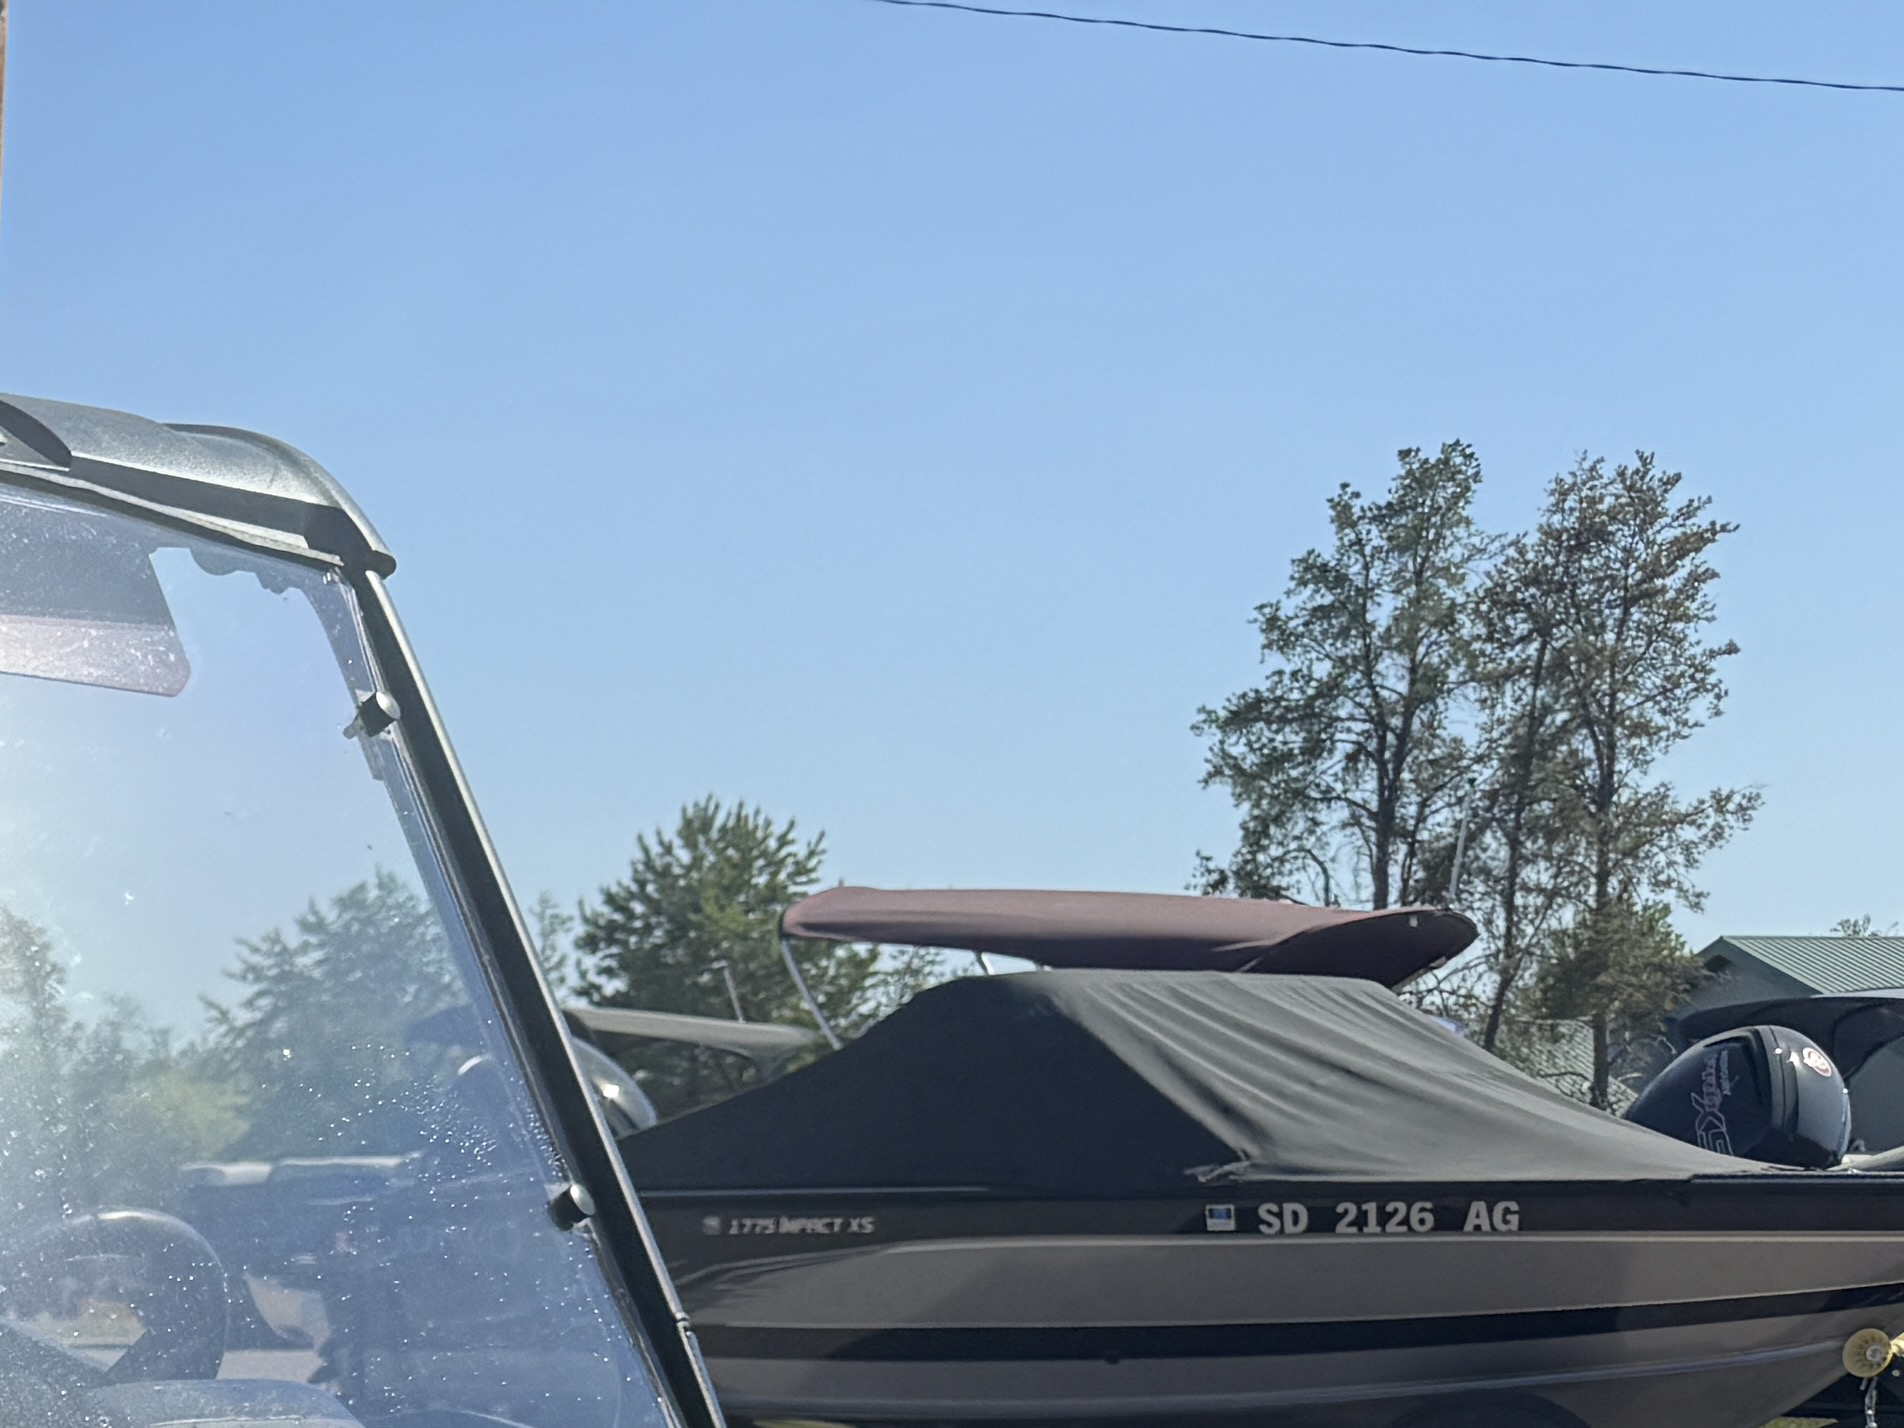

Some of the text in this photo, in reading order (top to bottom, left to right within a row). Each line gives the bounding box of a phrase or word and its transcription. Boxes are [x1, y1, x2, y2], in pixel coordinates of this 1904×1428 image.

[729, 1217, 775, 1234] 1775
[848, 1216, 875, 1234] XS
[1257, 1200, 1519, 1234] SD 2126 AG
